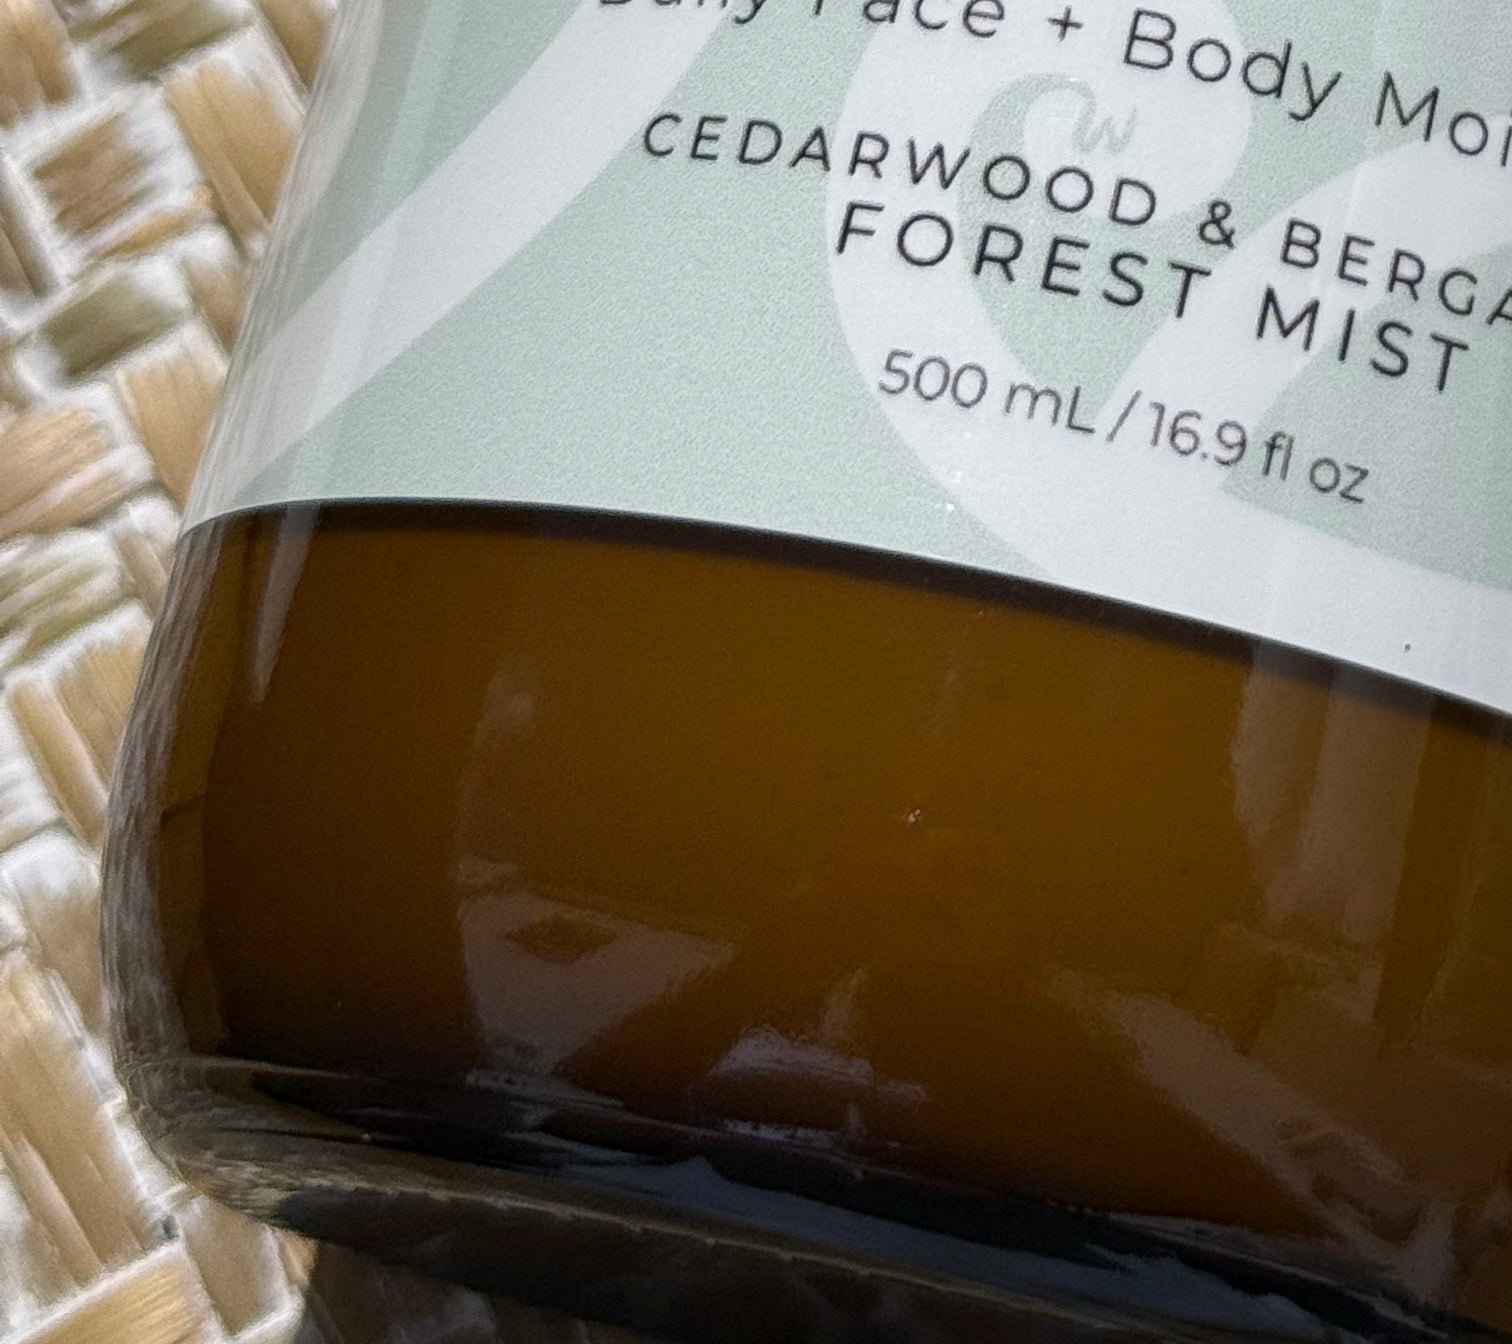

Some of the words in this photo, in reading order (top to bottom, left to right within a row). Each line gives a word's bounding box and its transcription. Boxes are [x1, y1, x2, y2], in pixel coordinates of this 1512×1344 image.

[1045, 4, 1085, 44] +
[1120, 5, 1345, 126] Body
[638, 109, 1159, 231] CEDARWOOD
[1194, 196, 1238, 252] &
[833, 198, 1214, 321] FOREST
[1253, 282, 1472, 396] MIST
[877, 346, 990, 412] 500
[1258, 429, 1298, 484] fl
[1307, 455, 1372, 507] oz
